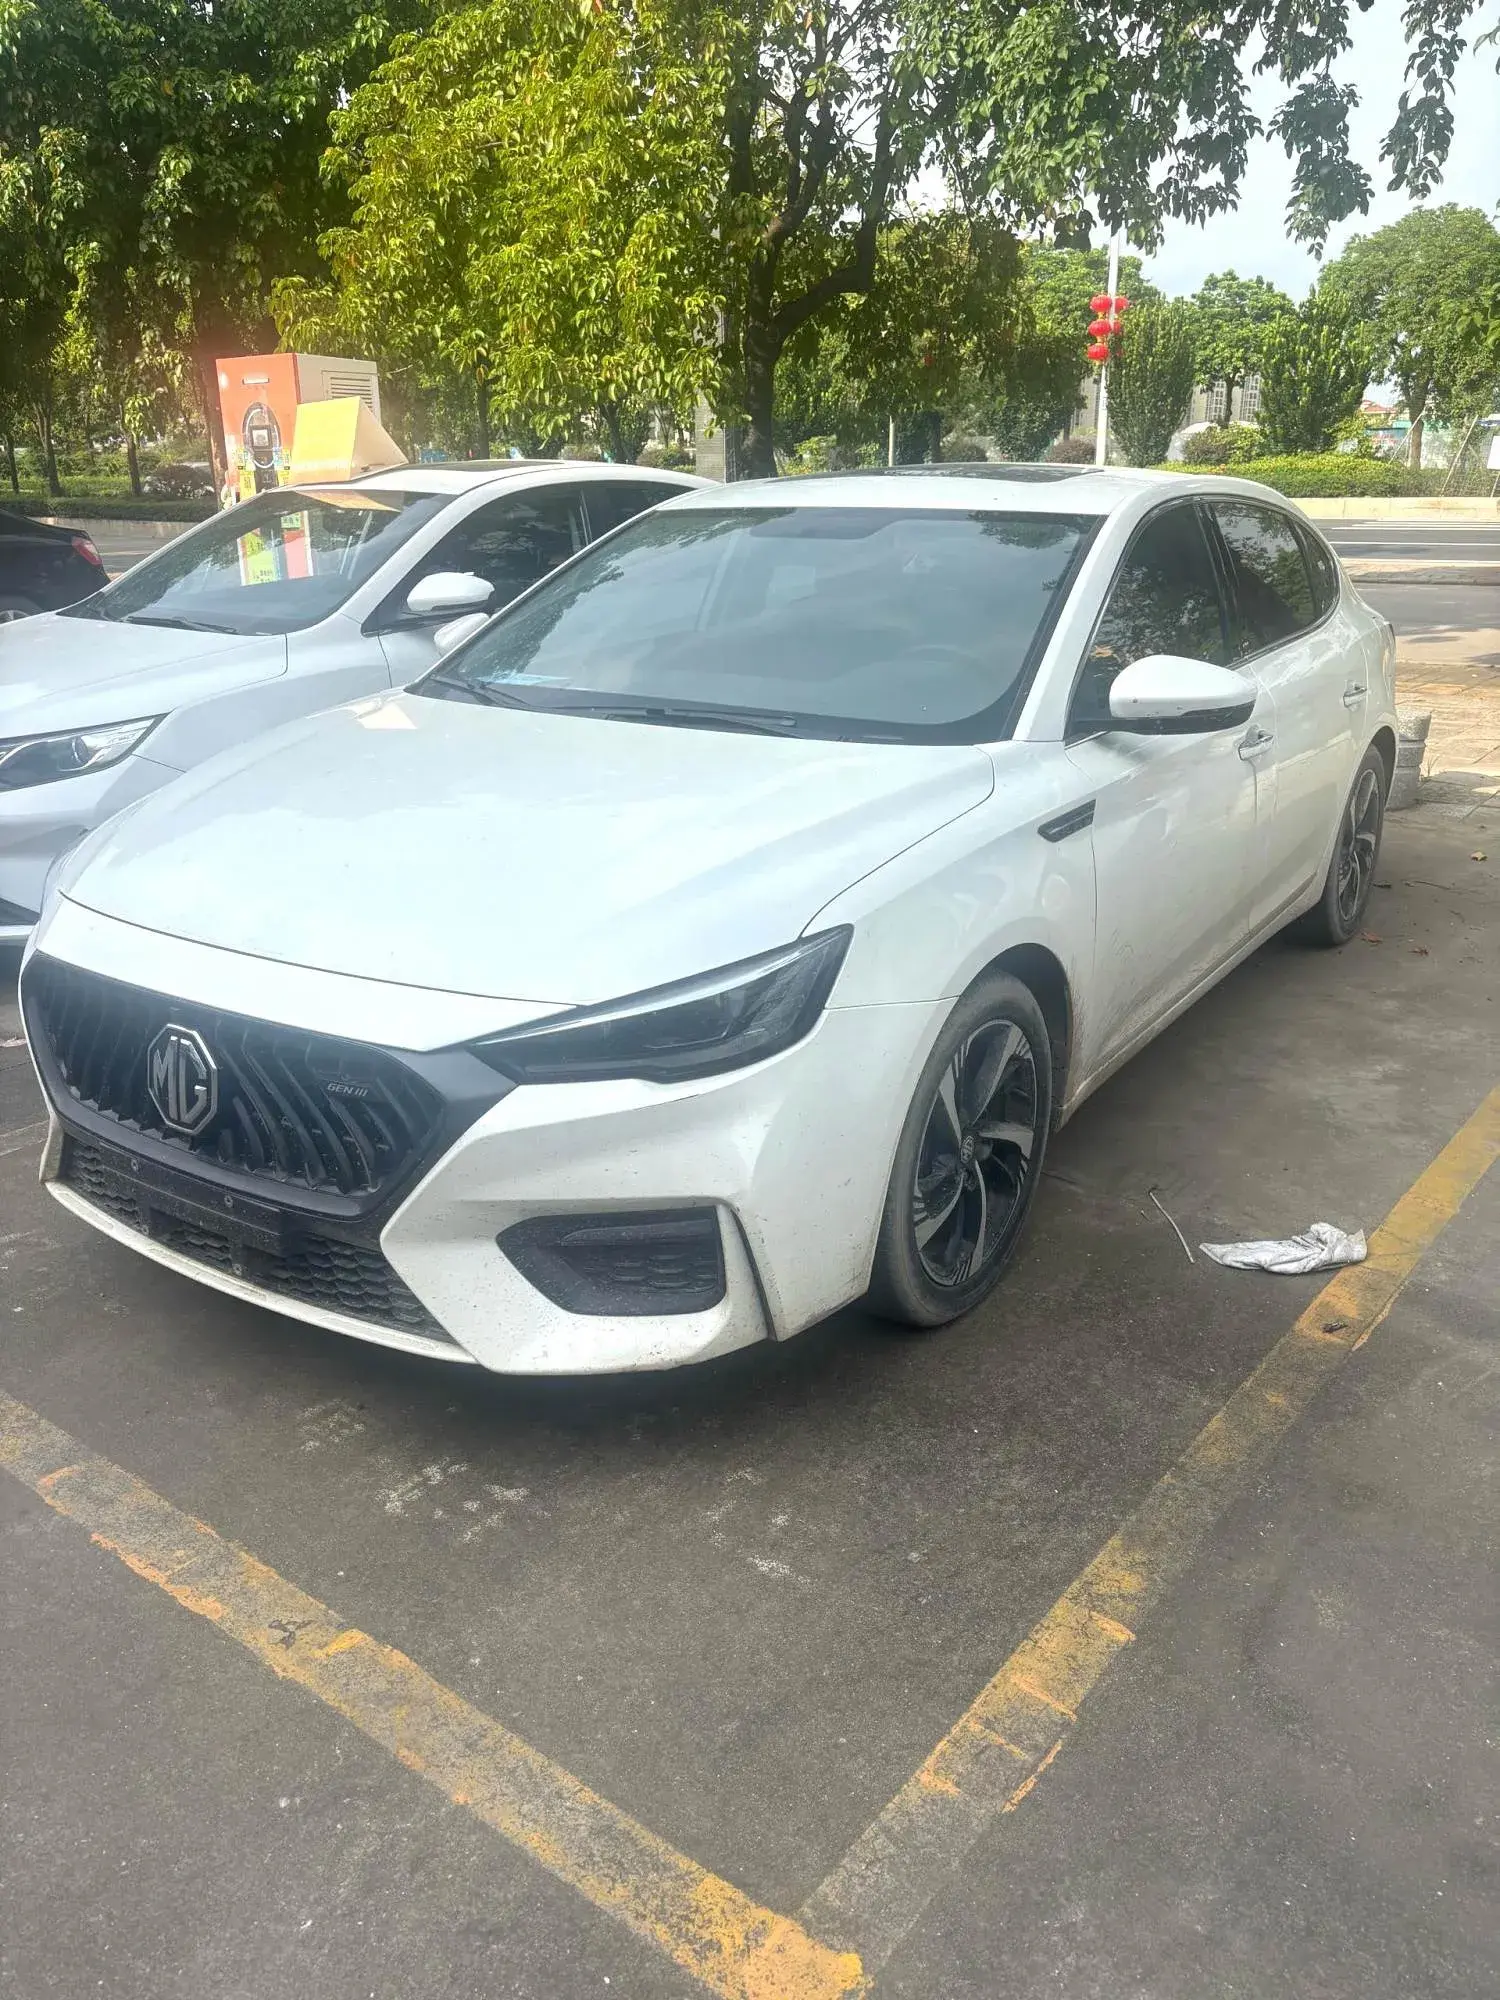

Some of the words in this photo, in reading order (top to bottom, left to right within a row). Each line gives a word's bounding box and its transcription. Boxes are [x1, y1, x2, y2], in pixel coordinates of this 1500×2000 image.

[152, 1035, 208, 1124] MG
[327, 1083, 354, 1095] GEN
[354, 1087, 369, 1097] III
